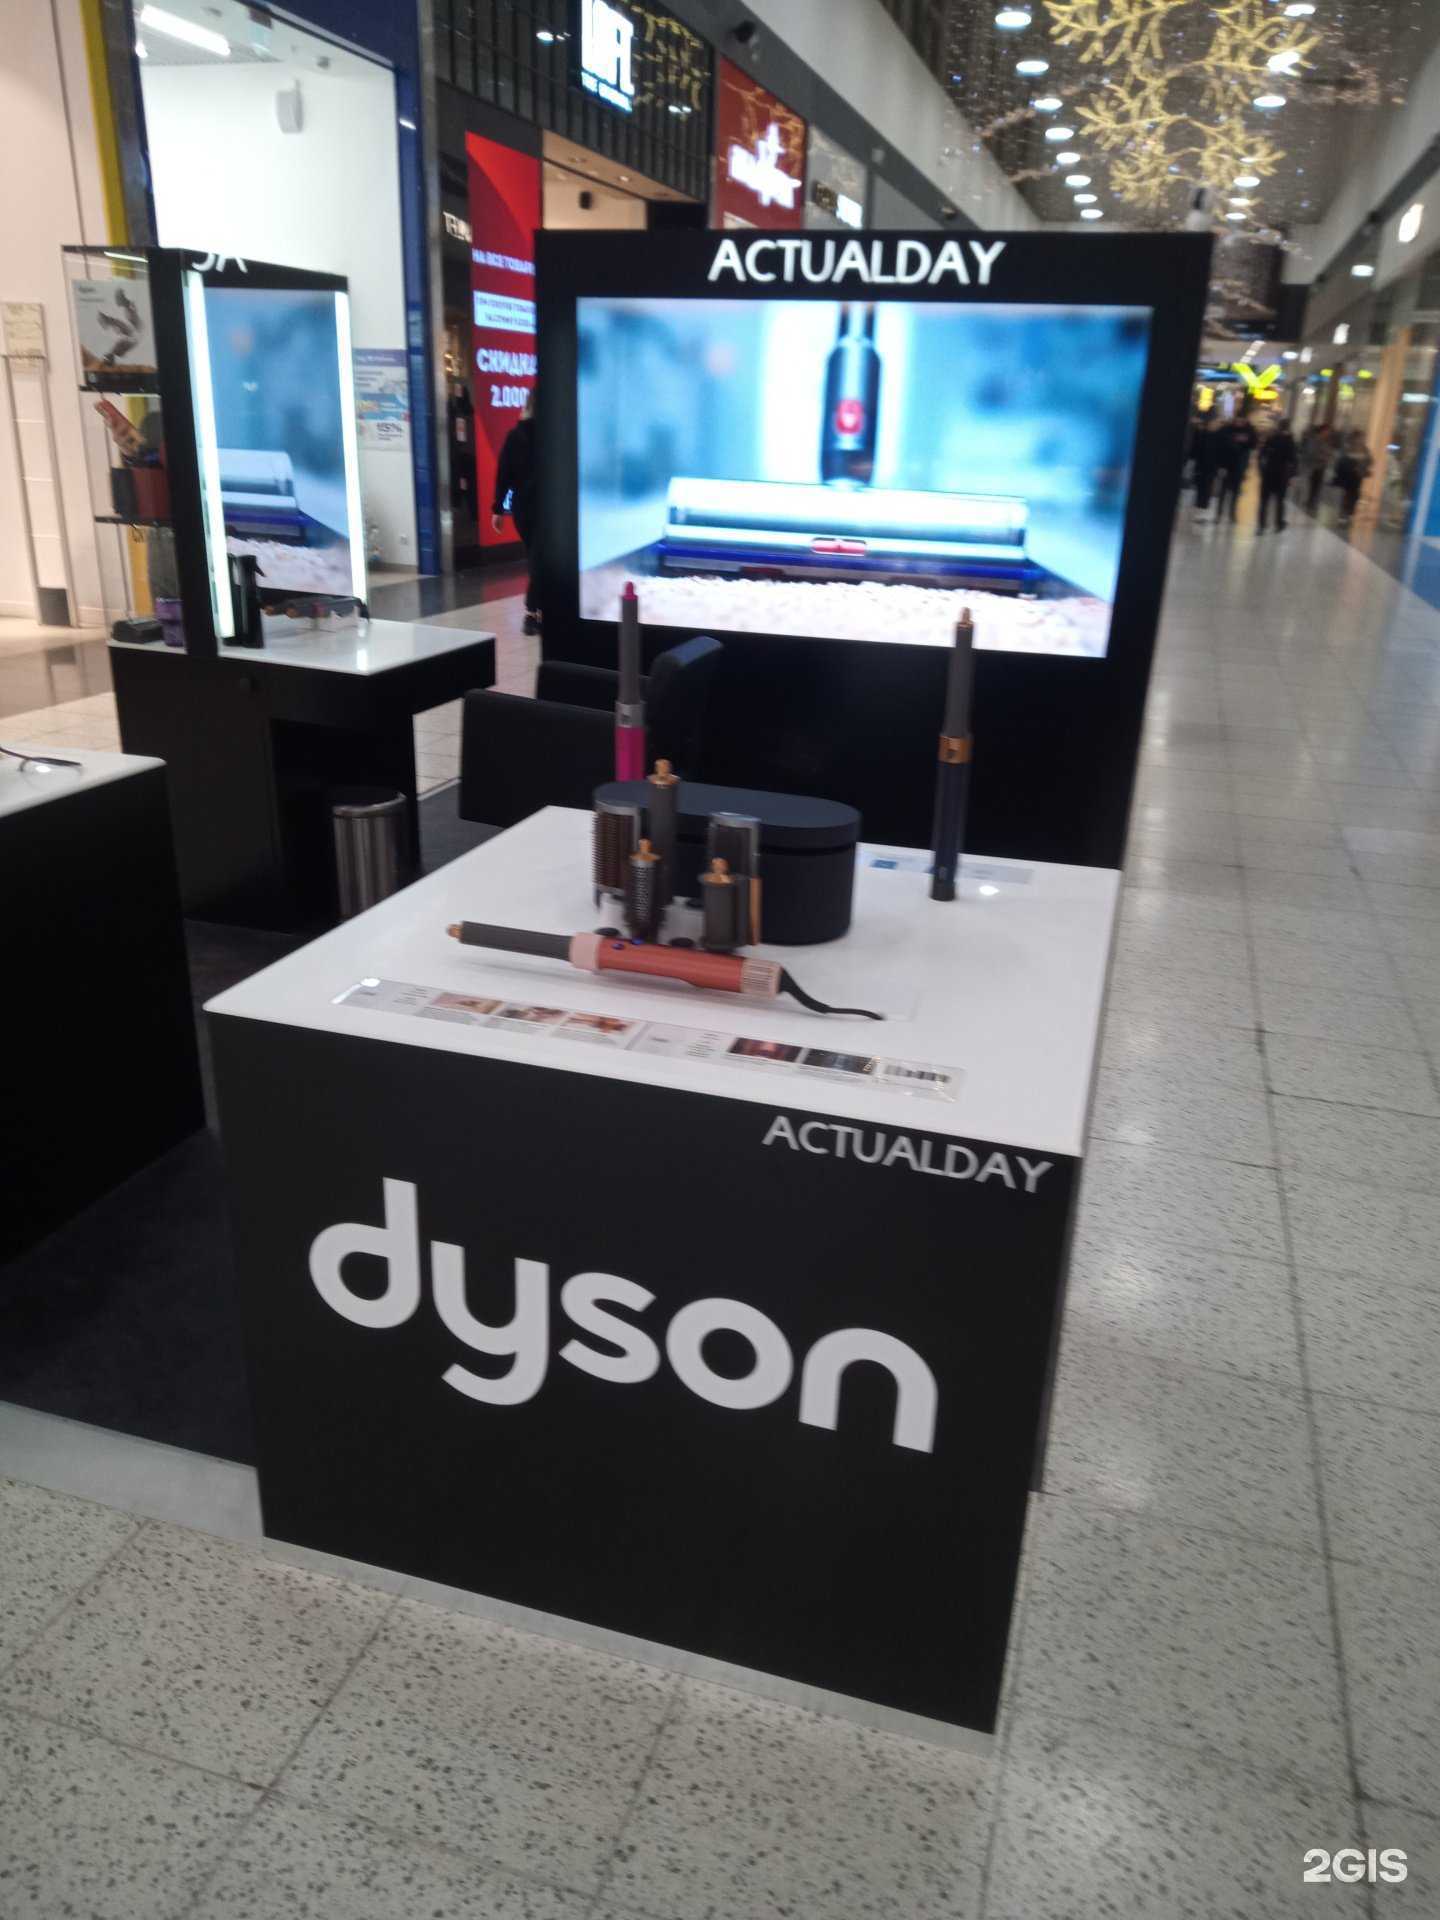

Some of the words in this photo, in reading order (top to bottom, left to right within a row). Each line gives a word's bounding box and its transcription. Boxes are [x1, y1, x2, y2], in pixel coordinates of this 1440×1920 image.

[707, 239, 1006, 285] ACTUALDAY
[761, 1115, 1054, 1194] ACTUALDAY
[308, 1176, 939, 1454] dyson
